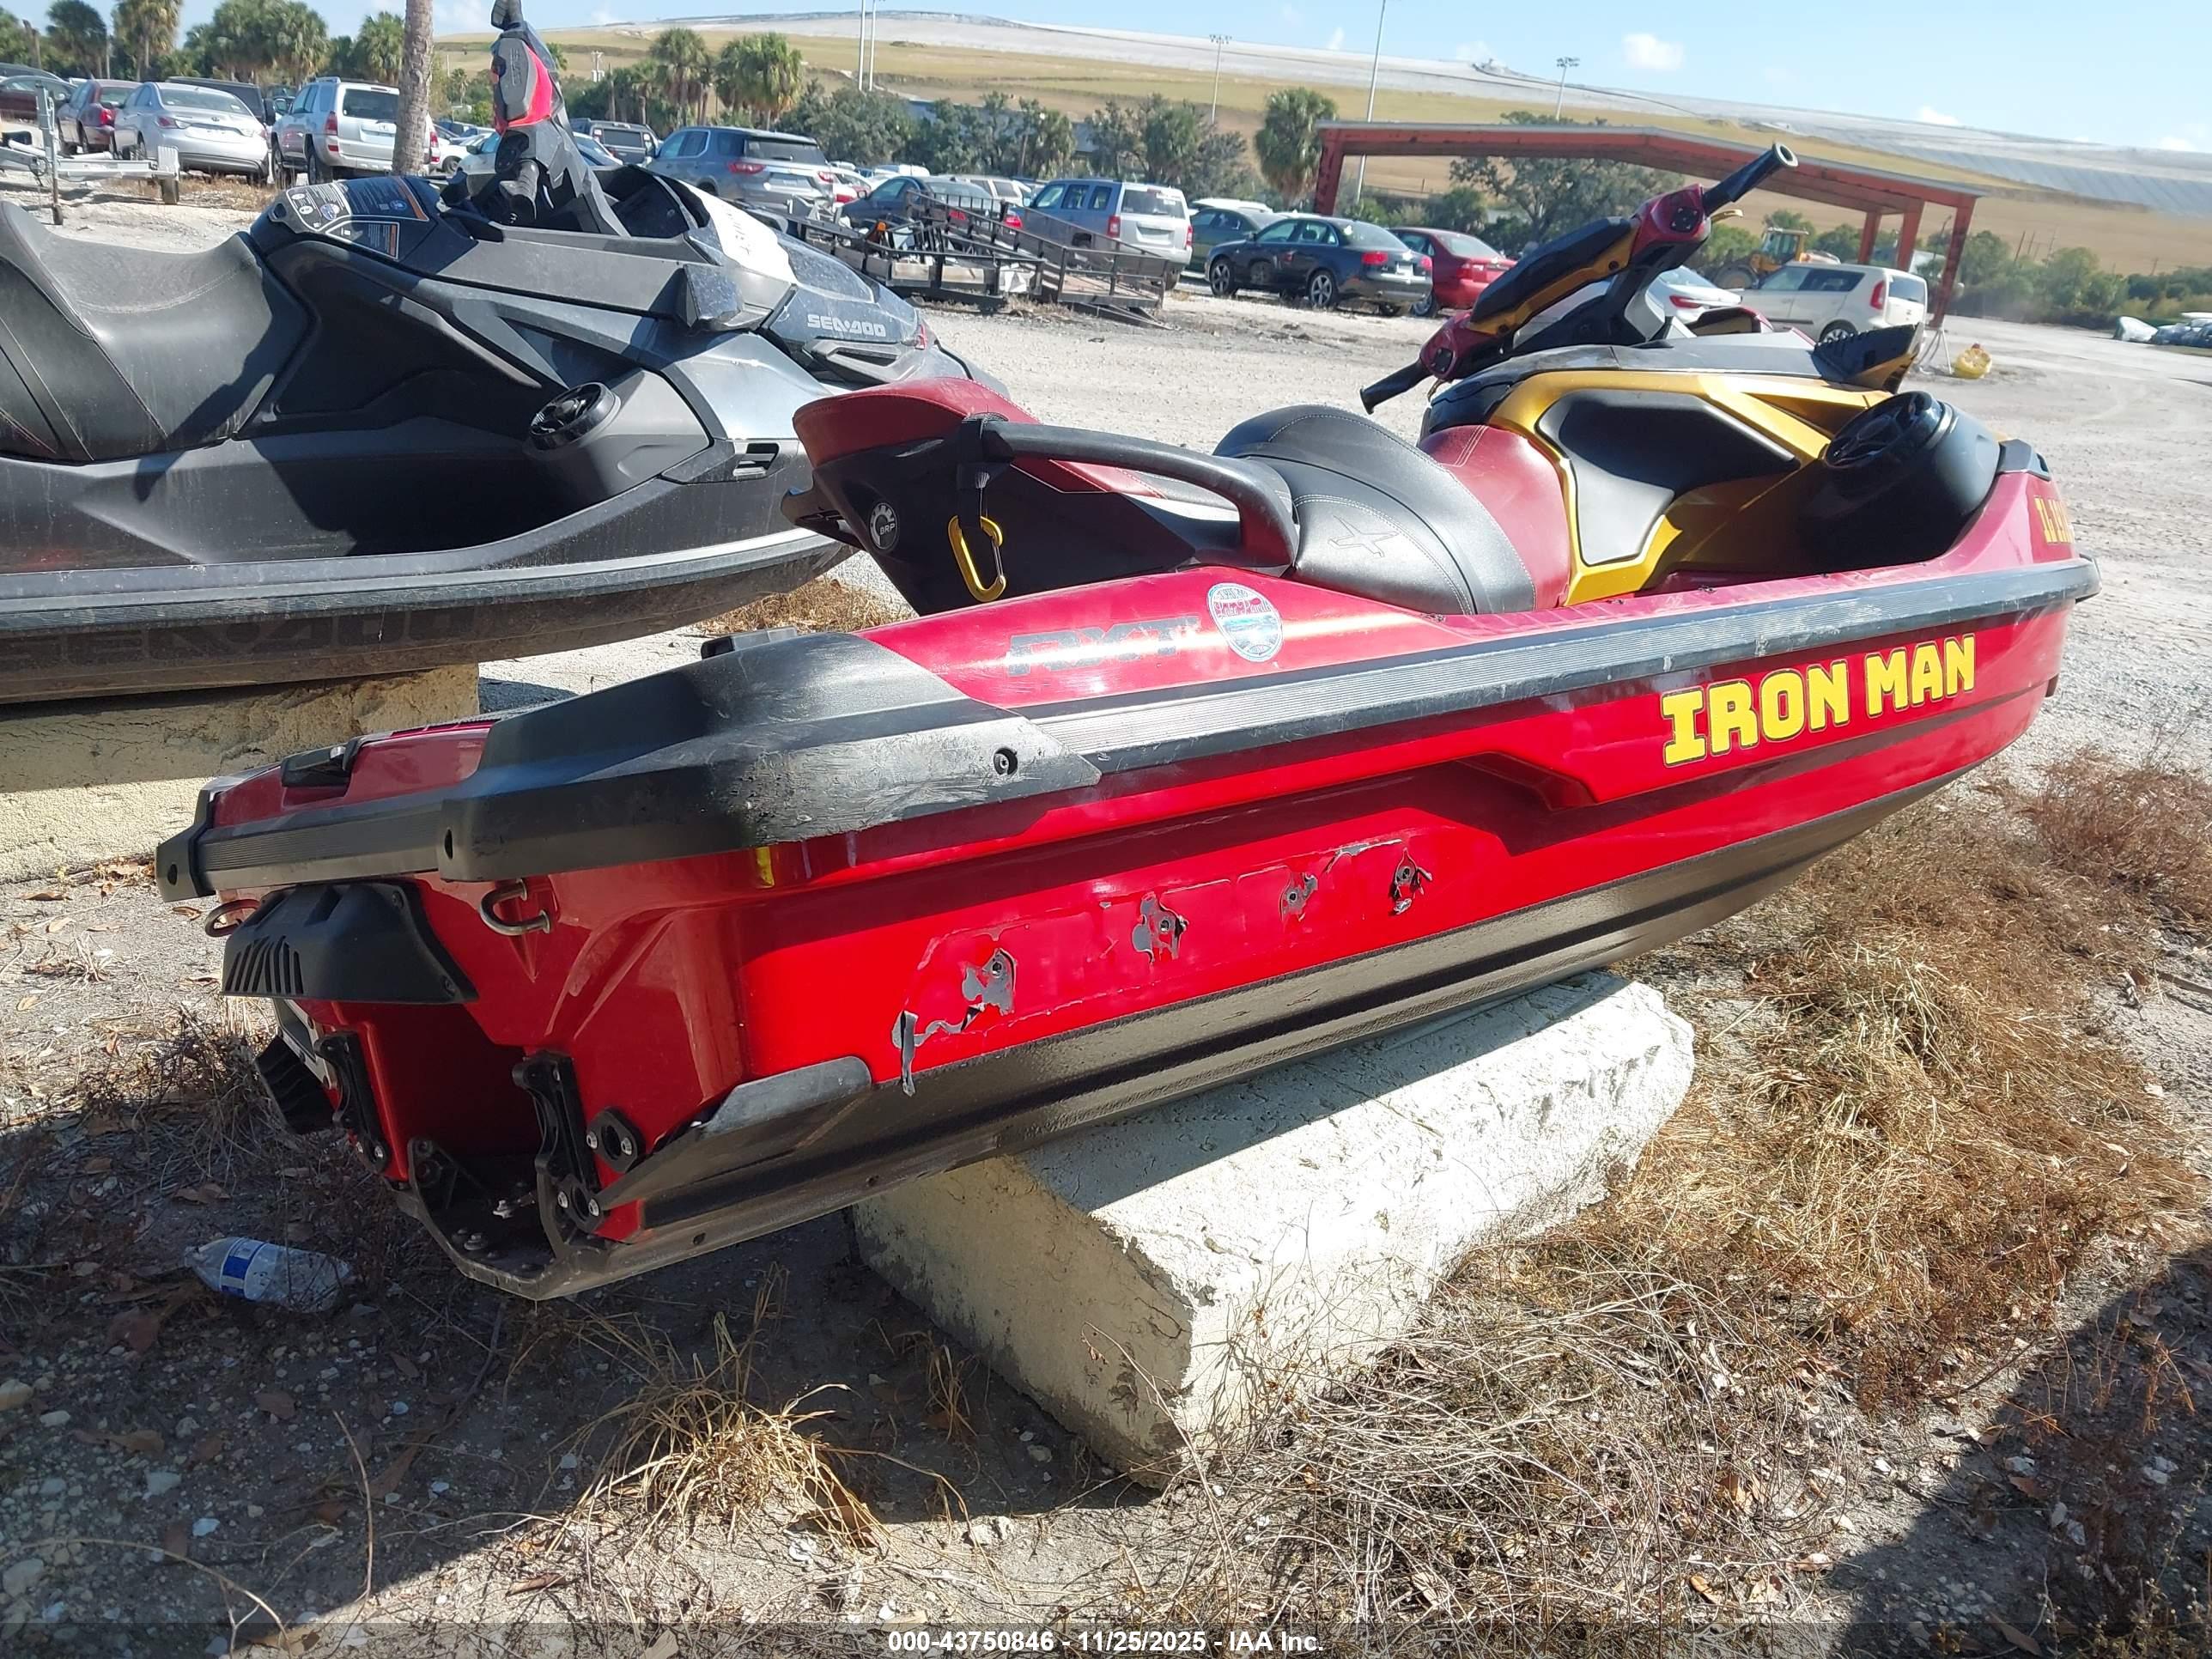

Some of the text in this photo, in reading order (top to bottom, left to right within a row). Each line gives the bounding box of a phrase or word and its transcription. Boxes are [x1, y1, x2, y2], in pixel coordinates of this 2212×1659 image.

[879, 522, 895, 536] BRP
[1662, 633, 1976, 767] IRON MAN
